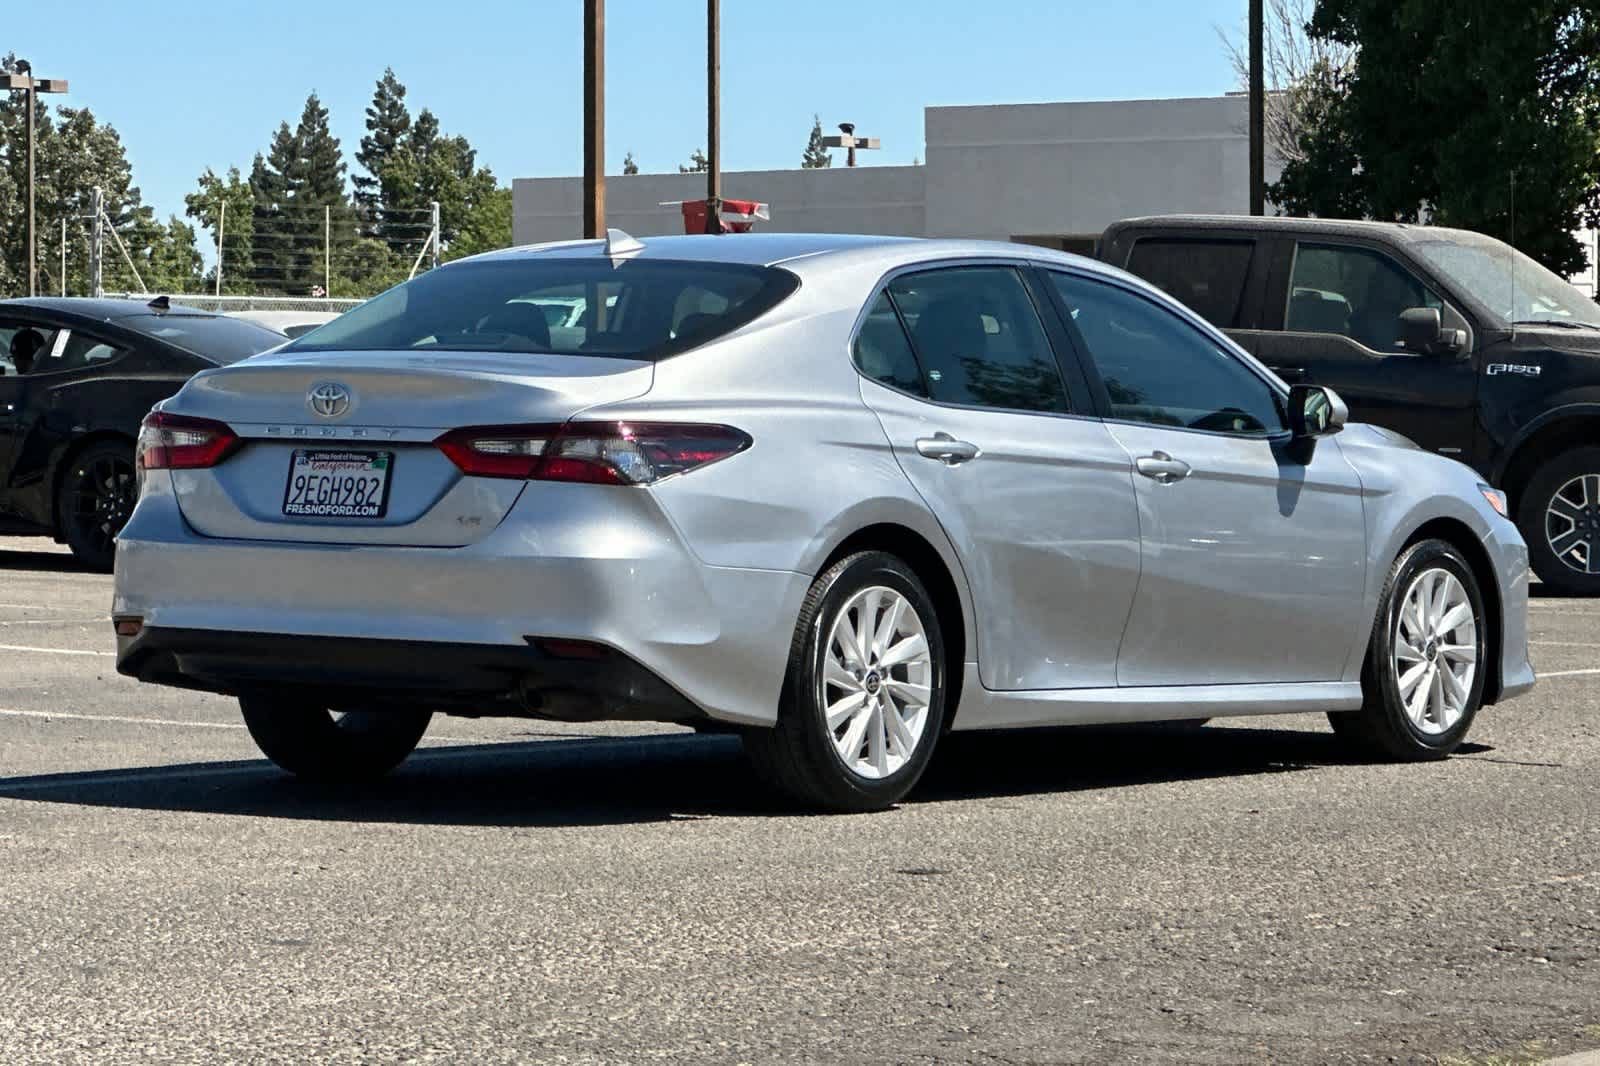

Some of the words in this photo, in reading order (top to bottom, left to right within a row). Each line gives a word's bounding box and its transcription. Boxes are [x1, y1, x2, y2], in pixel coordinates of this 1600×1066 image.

[312, 461, 371, 474] California
[292, 475, 380, 506] 9EGH982
[285, 504, 379, 516] FRESNOFORD.COM
